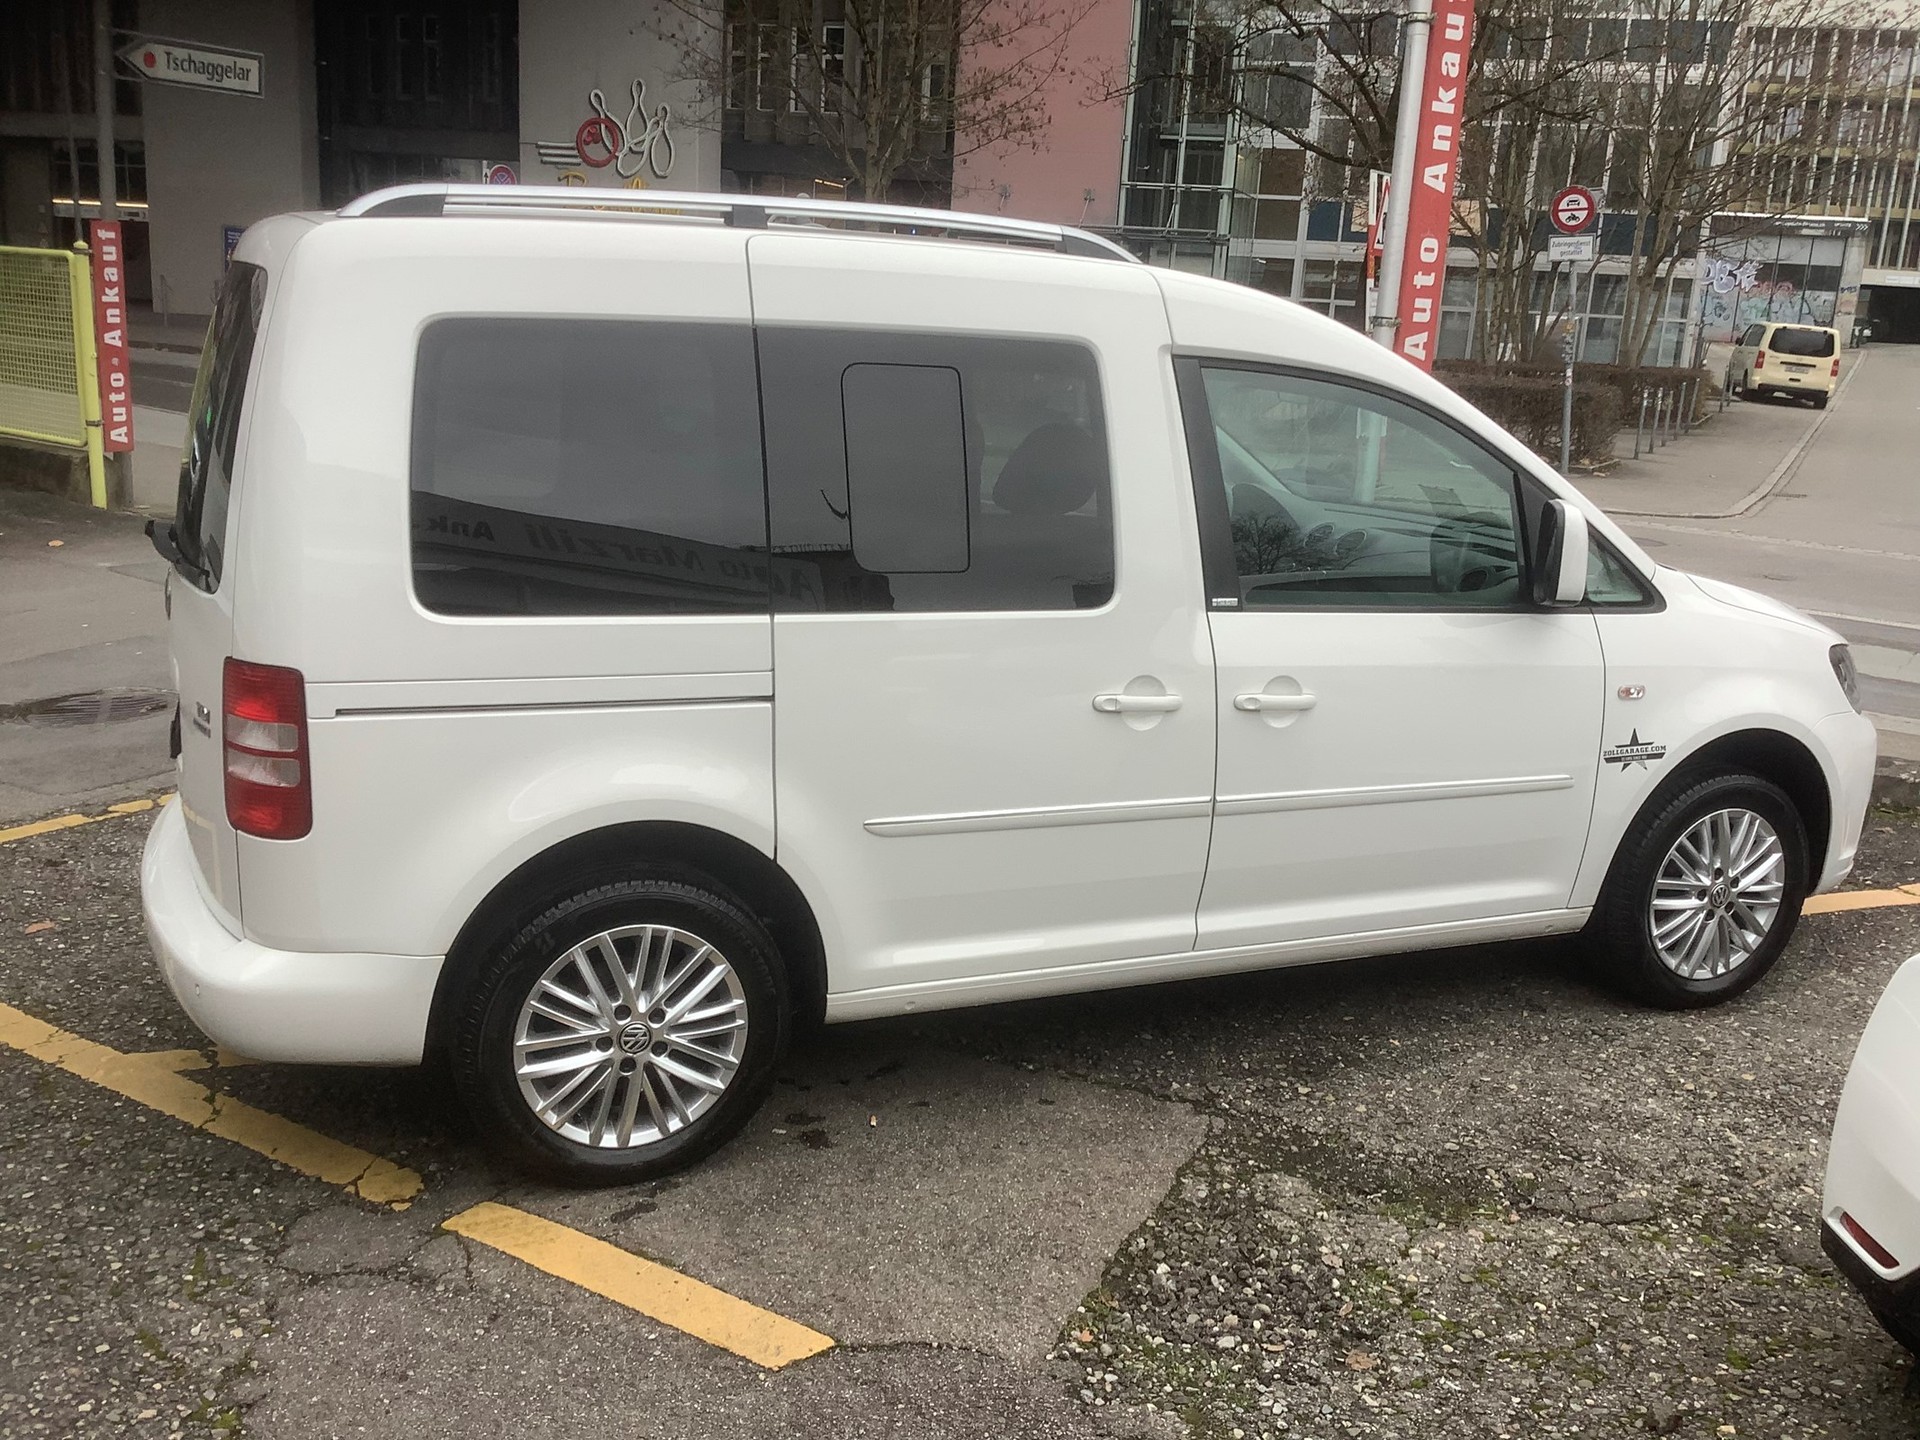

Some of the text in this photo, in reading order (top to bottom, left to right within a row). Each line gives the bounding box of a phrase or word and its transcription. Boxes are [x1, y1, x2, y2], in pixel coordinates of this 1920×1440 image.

[164, 51, 251, 82] Tschaggelar
[1404, 0, 1466, 361] Auto Ankau
[98, 229, 128, 443] Auto Ankauf
